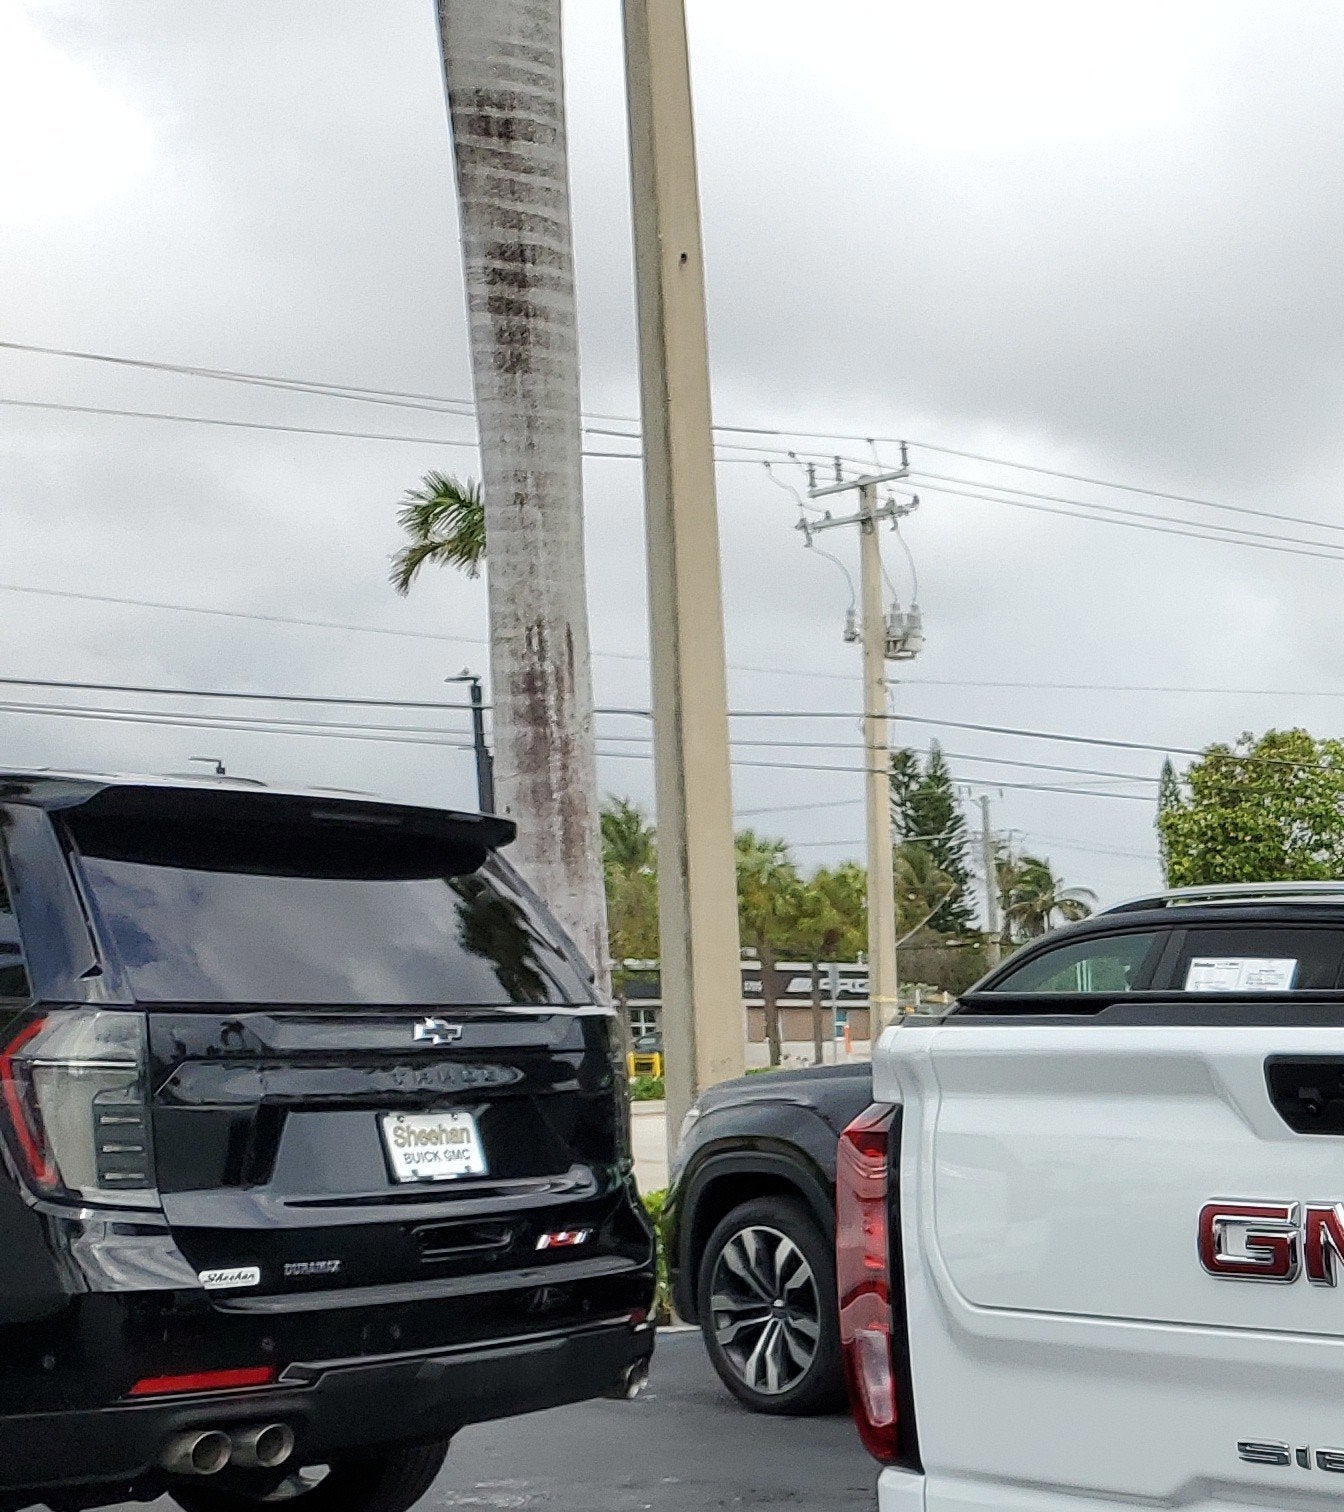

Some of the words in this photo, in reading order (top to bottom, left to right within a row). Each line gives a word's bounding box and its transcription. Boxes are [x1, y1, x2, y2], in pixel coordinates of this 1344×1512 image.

[392, 1122, 471, 1148] Sheehan
[403, 1151, 440, 1164] BUICK
[443, 1148, 471, 1161] GMC
